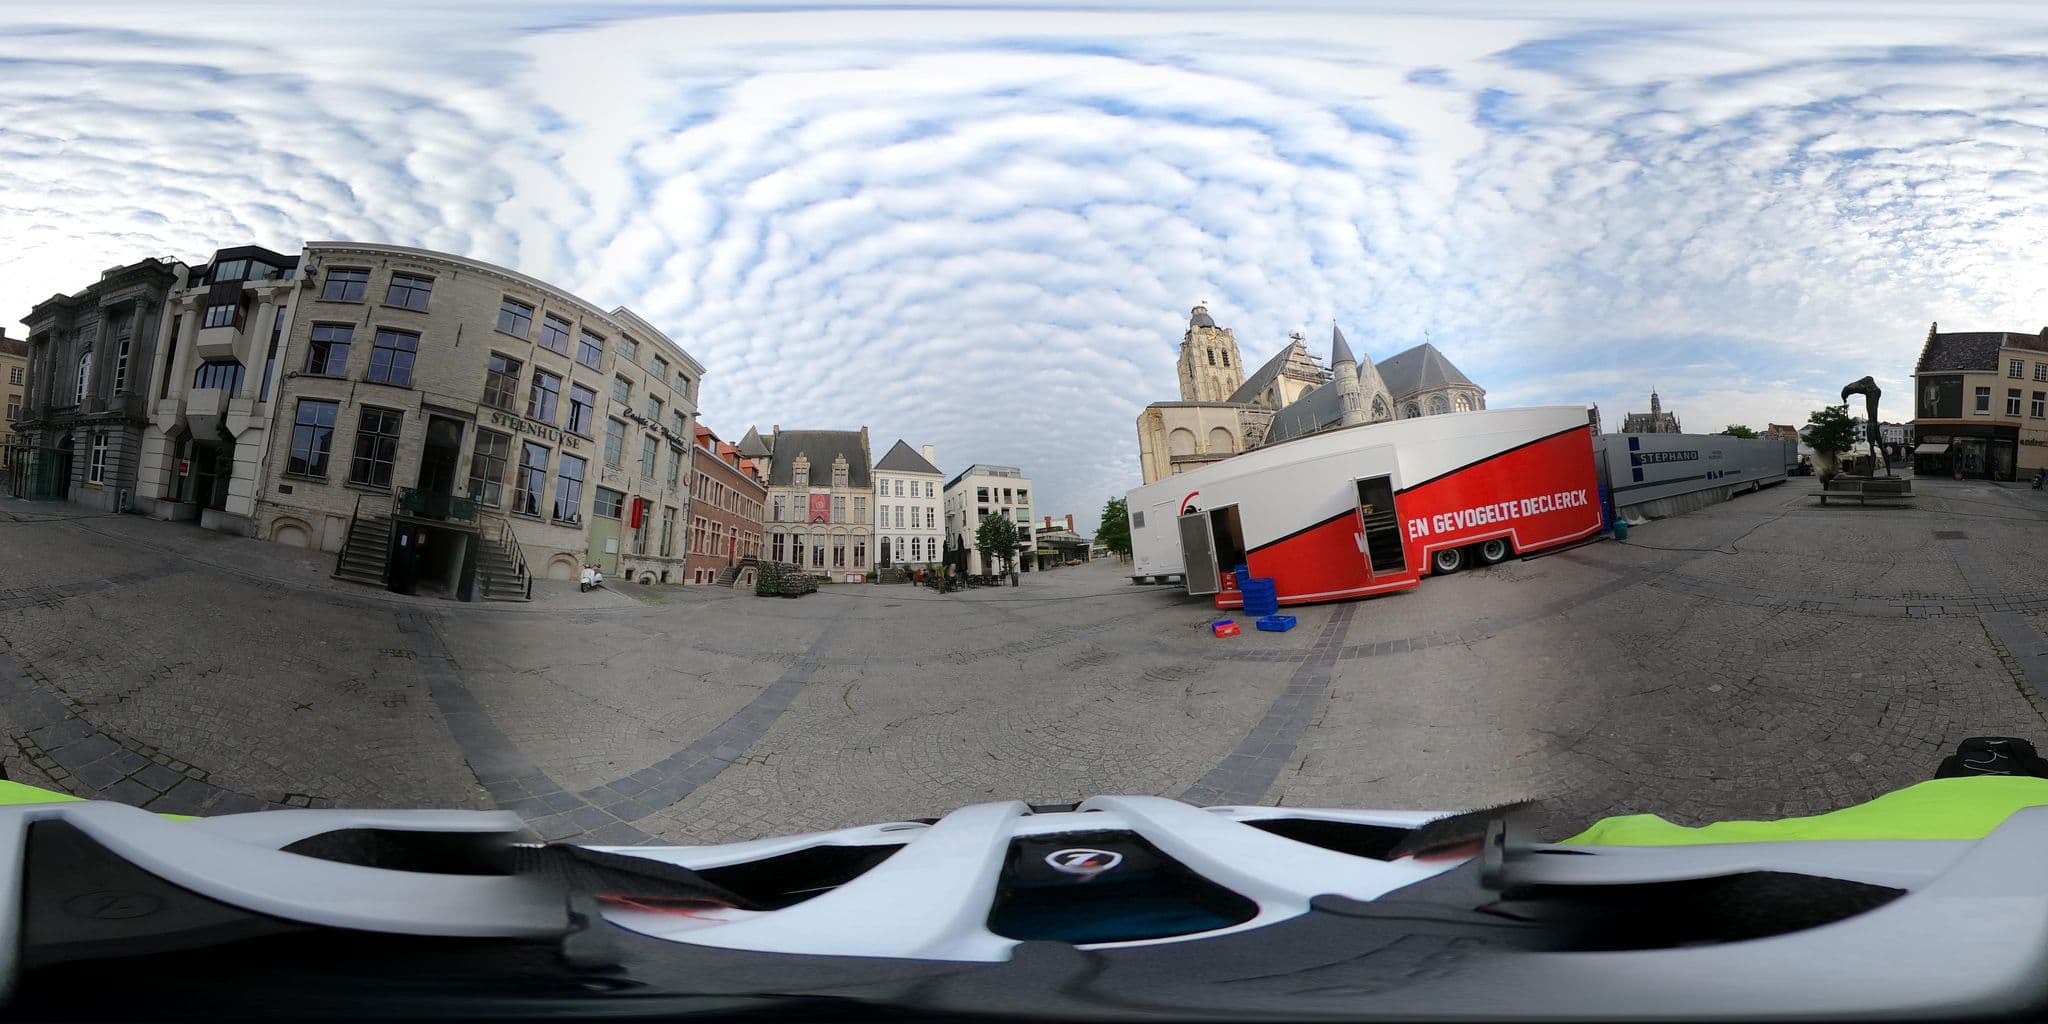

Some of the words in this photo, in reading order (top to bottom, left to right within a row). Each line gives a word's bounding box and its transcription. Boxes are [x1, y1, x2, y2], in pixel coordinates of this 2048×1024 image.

[491, 411, 581, 449] STEENHUYSE
[1640, 451, 1697, 464] STEPHANO
[1408, 517, 1430, 541] EN
[1432, 501, 1520, 534] GEVOGELTE
[1520, 489, 1588, 517] DECLERCK
